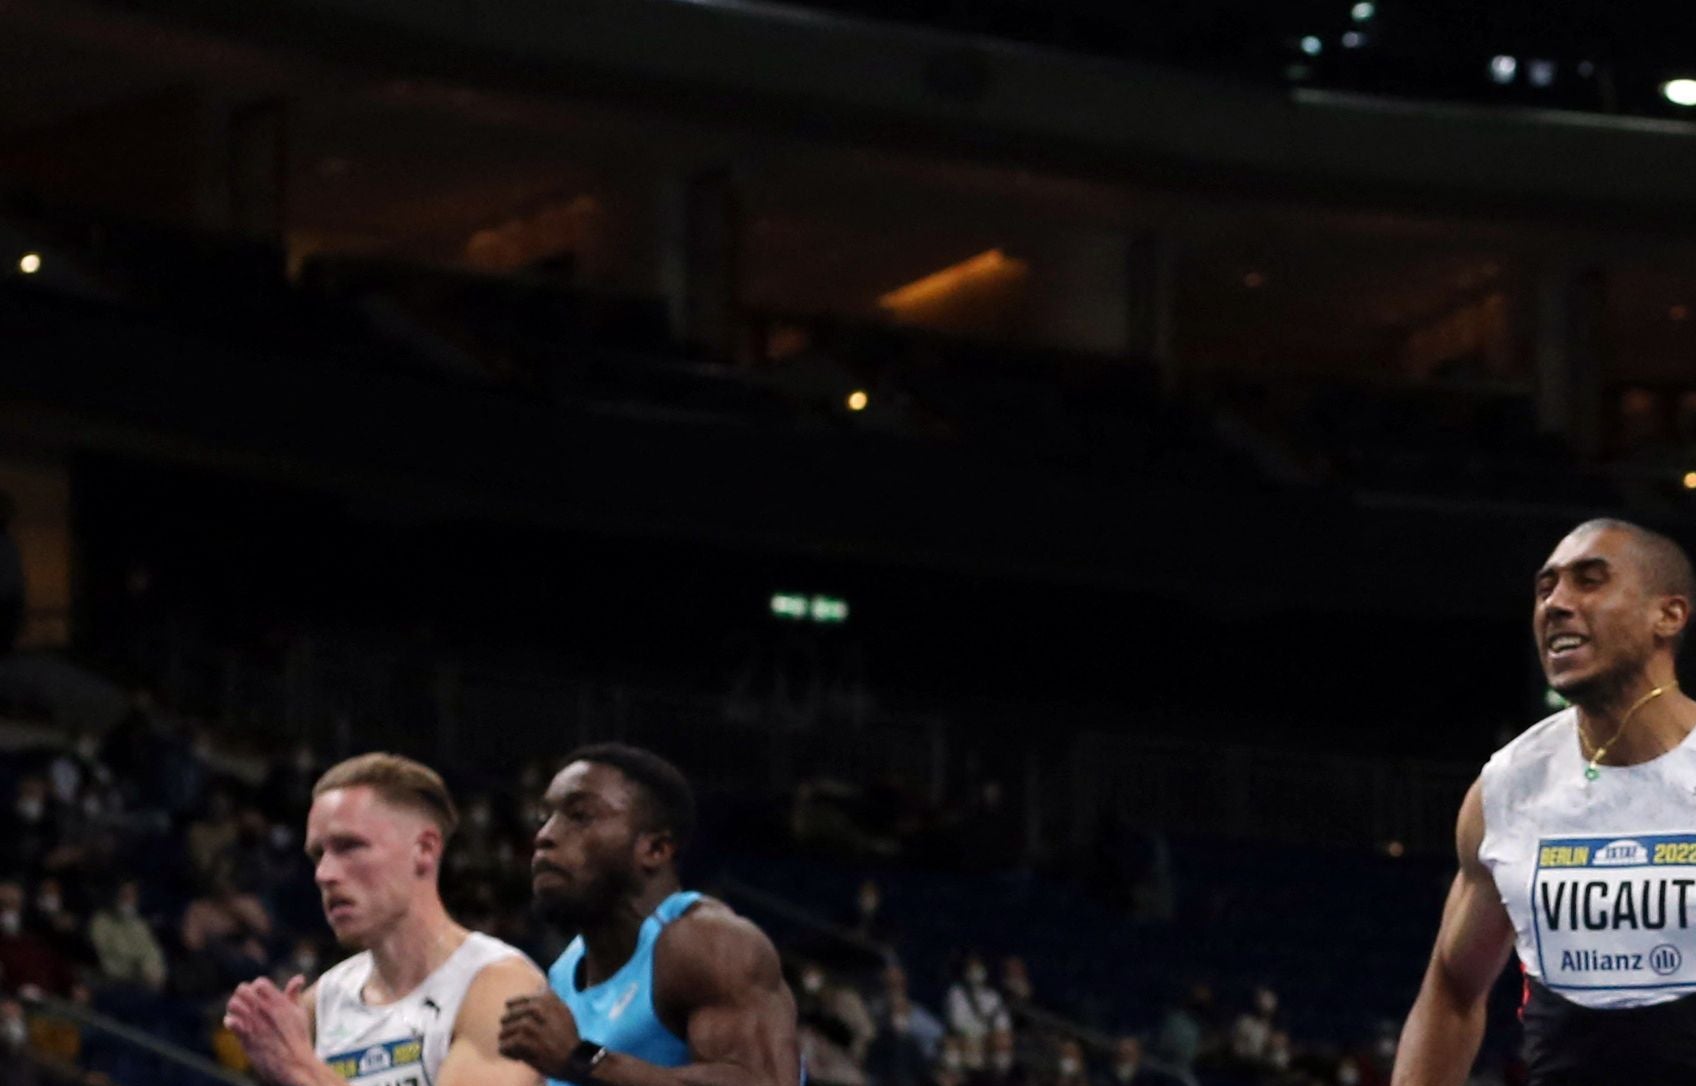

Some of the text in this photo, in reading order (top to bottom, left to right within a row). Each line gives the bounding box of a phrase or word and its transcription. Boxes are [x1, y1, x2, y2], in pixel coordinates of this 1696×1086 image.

[1541, 848, 1588, 866] BERLIN
[1542, 880, 1695, 931] VICAUT
[1561, 950, 1643, 971] Allianz
